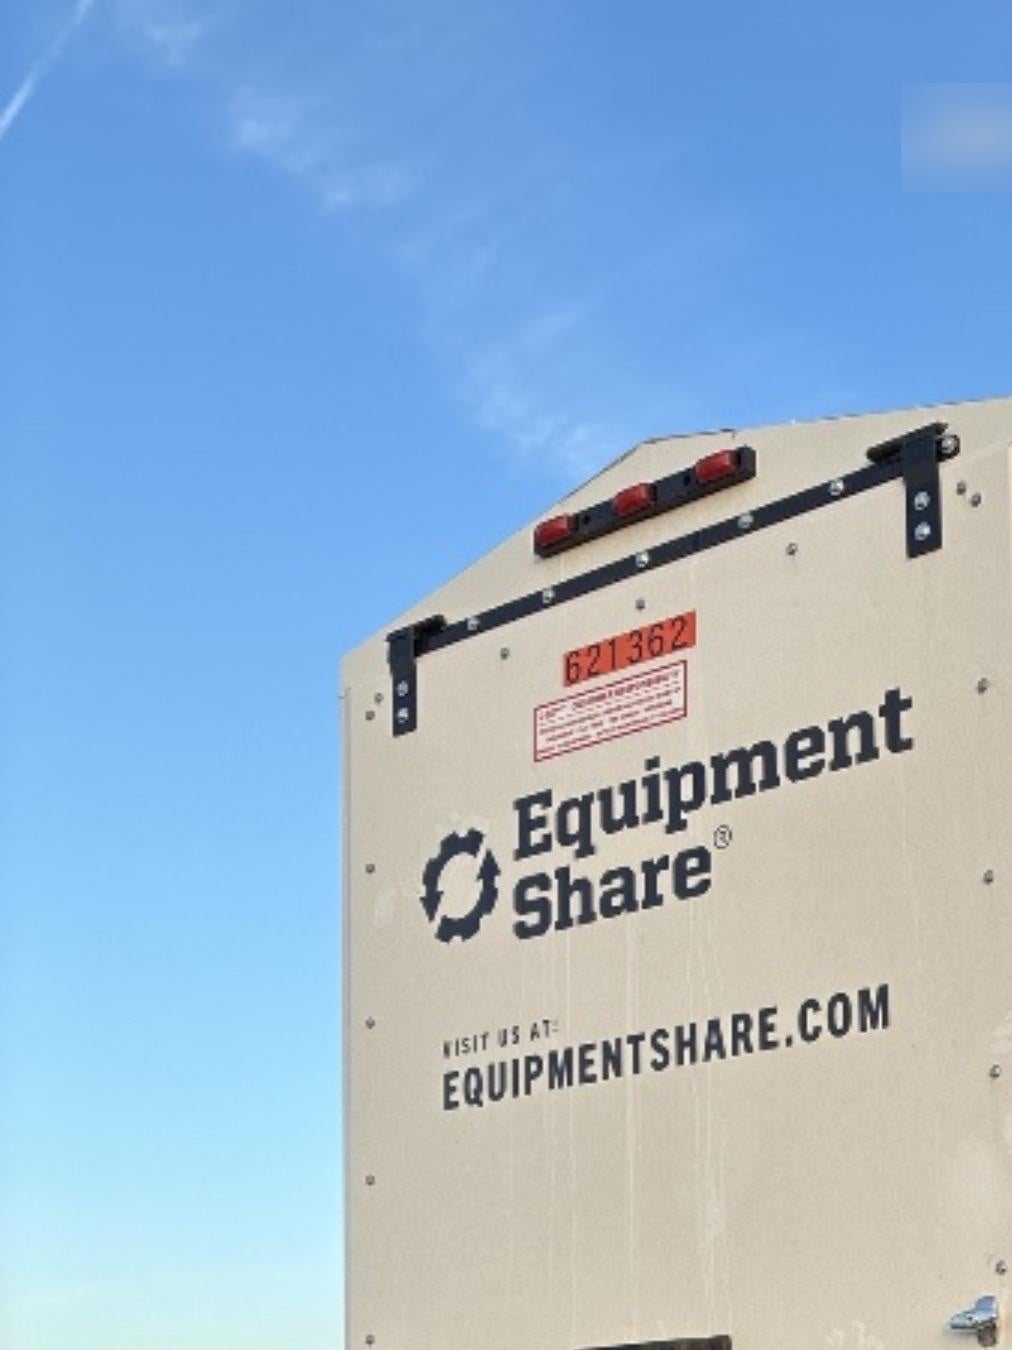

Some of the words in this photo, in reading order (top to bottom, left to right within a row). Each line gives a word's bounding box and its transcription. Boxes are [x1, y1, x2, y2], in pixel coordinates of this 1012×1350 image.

[565, 615, 687, 684] 621362
[513, 687, 913, 860] Equipment
[443, 1032, 489, 1059] VISIT
[498, 1024, 520, 1048] US
[443, 983, 889, 1111] EQUIPMENTSHARE.COM
